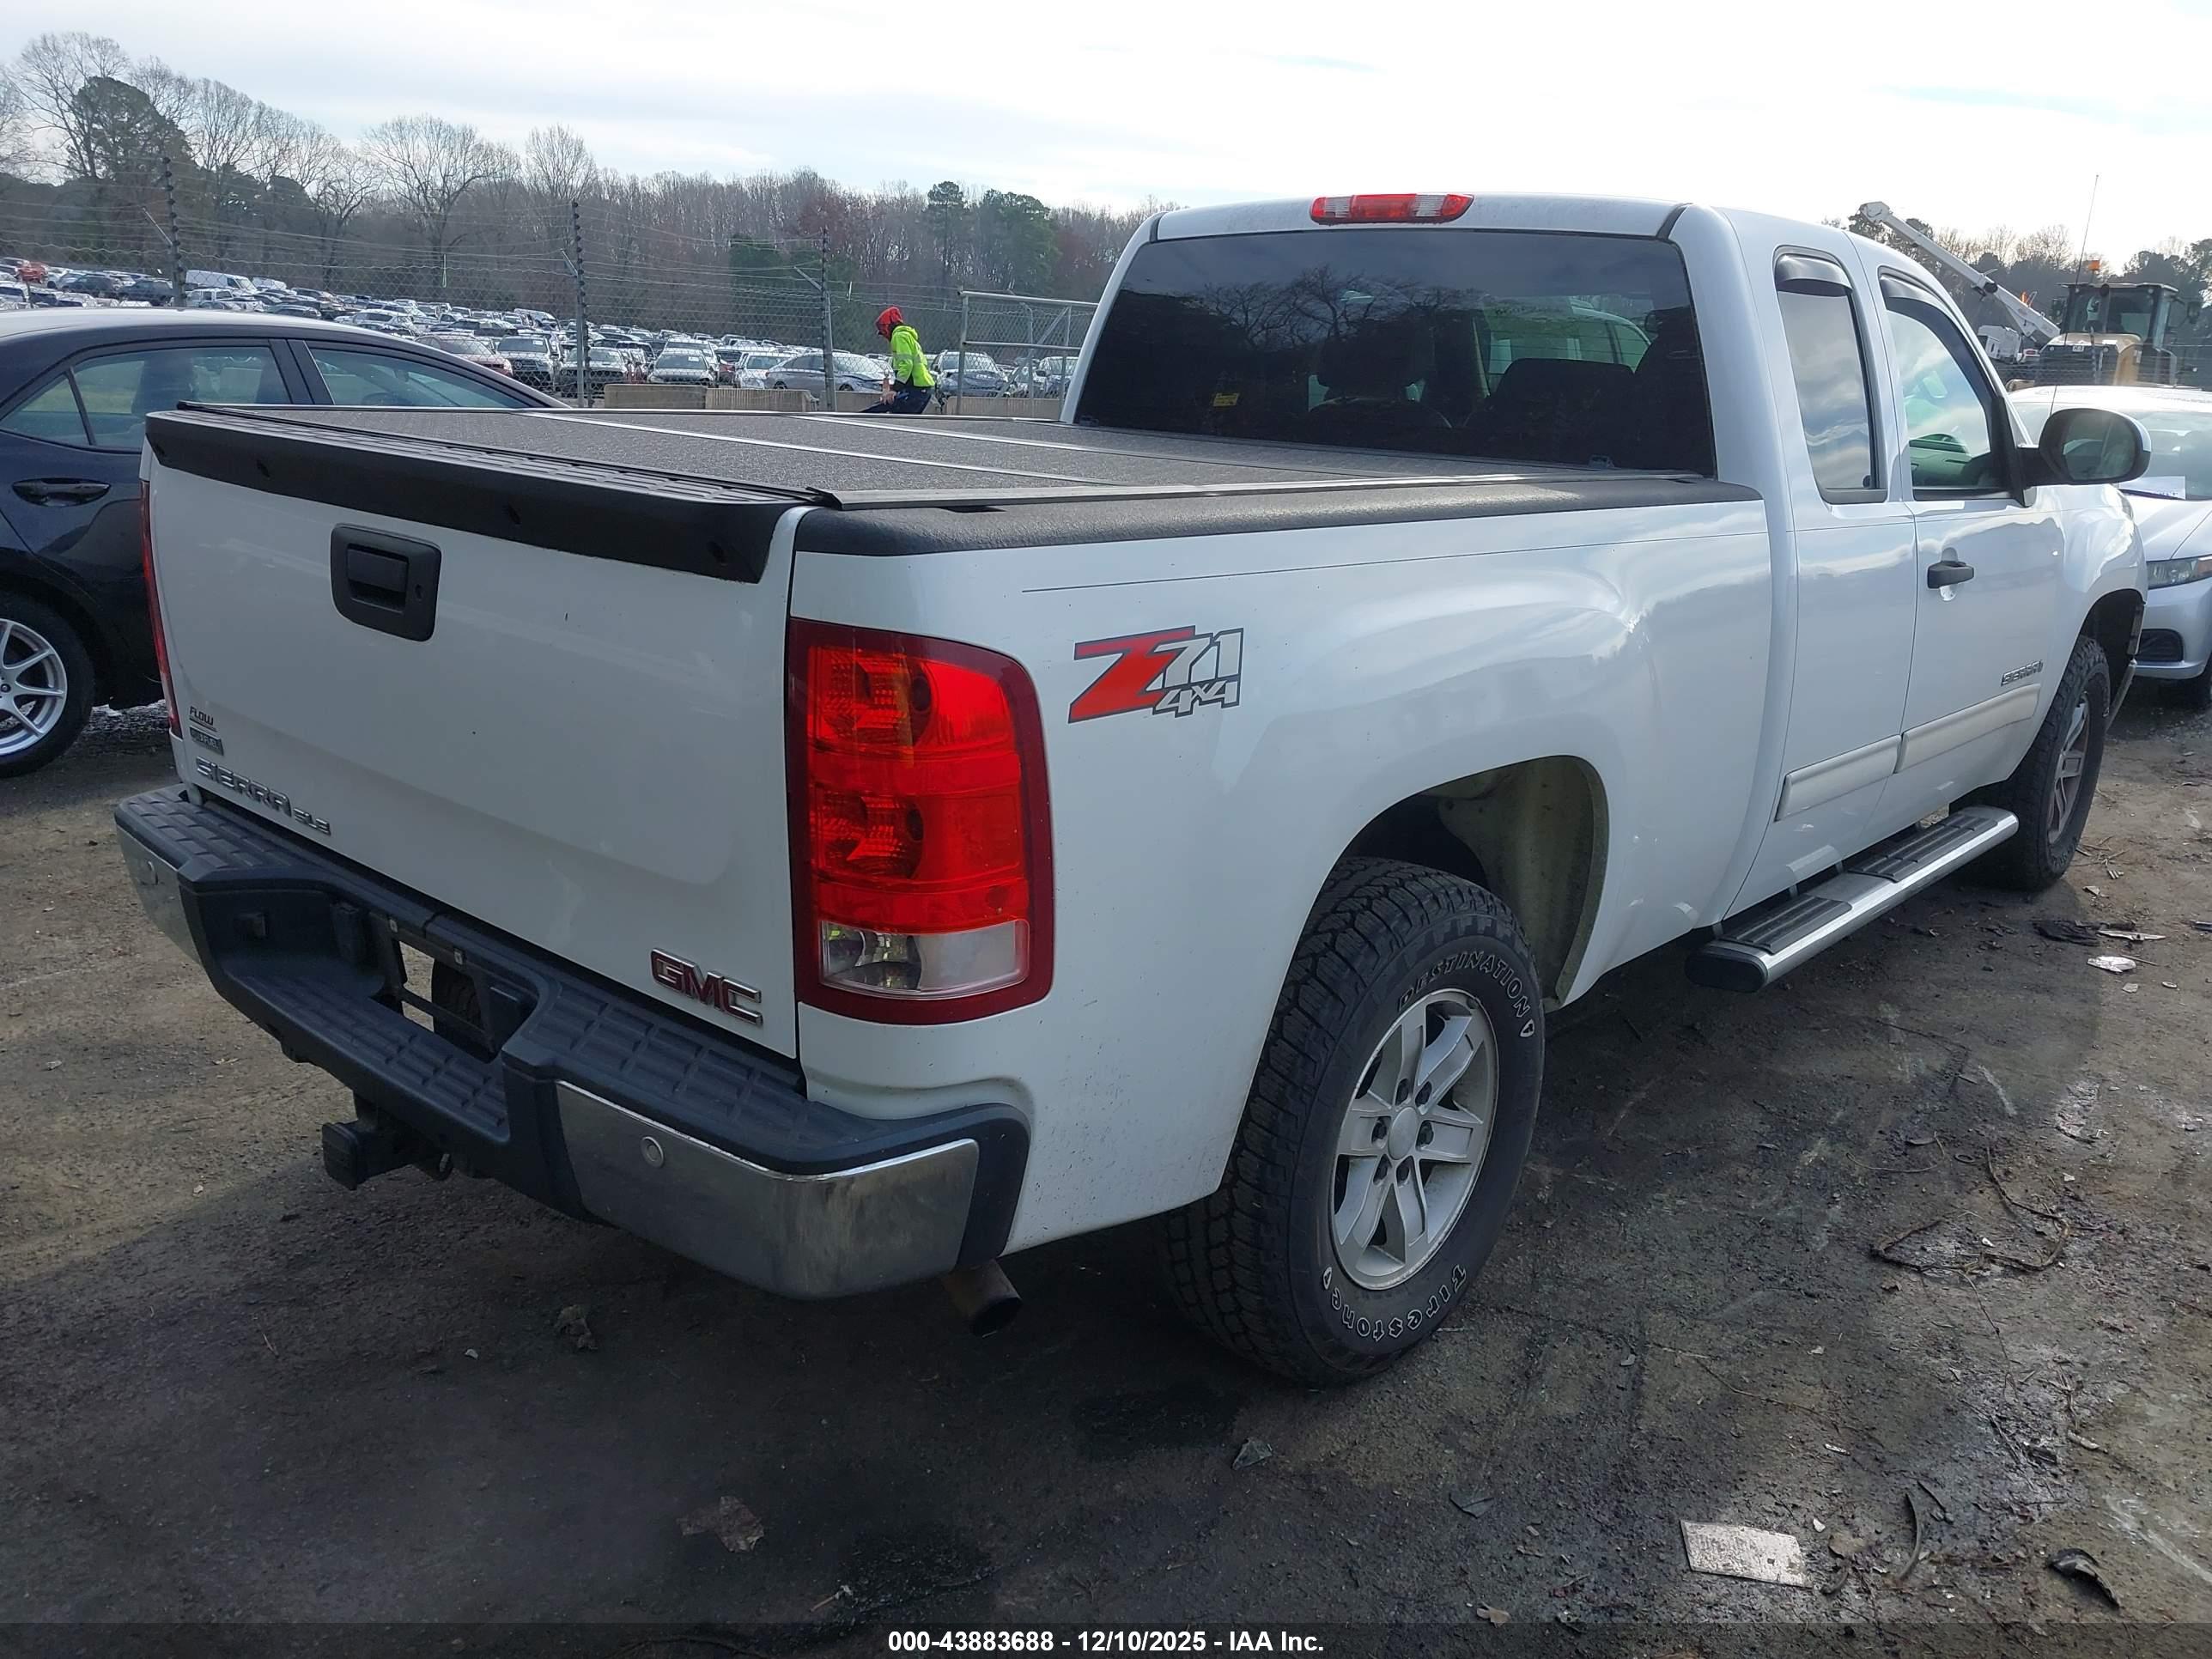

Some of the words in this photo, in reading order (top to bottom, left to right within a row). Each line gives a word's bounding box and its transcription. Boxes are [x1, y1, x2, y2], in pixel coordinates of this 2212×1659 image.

[1067, 624, 1244, 724] Z71
[189, 706, 214, 726] FLOW
[196, 756, 292, 817] SIERRA
[293, 807, 331, 836] SLE
[650, 947, 763, 1026] GMC
[1397, 950, 1531, 1019] DESTINATION
[1331, 1264, 1468, 1342] Firestone
